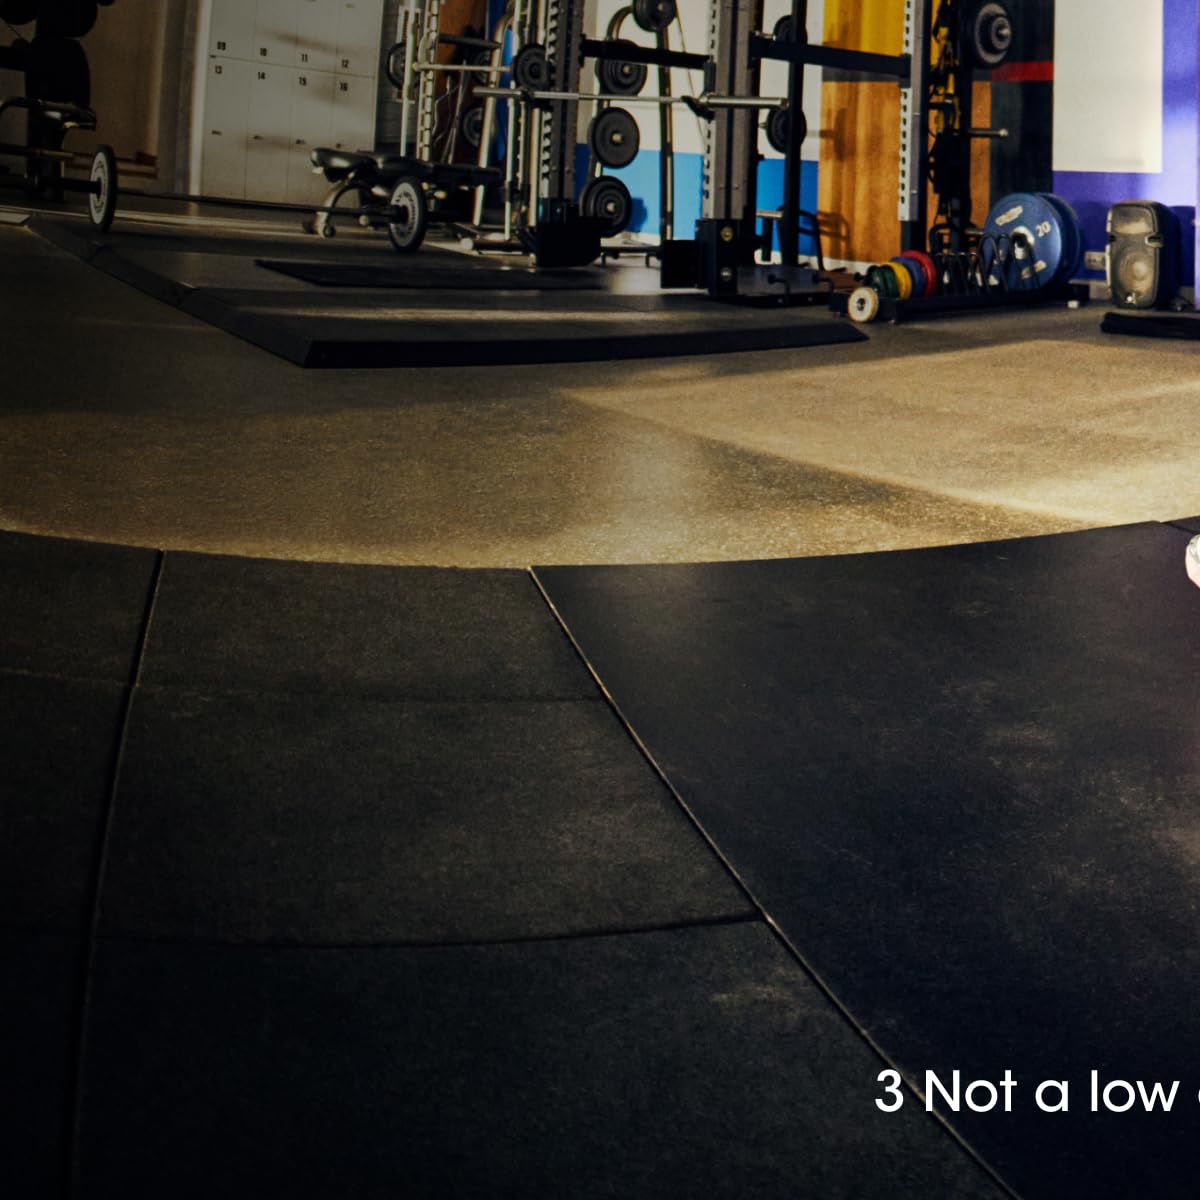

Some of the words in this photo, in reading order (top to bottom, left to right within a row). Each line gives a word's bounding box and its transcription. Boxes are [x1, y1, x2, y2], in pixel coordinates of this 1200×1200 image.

[260, 47, 267, 56] 10
[302, 54, 308, 62] 11
[342, 59, 349, 68] 12
[257, 71, 266, 80] 14
[1035, 221, 1051, 237] 20
